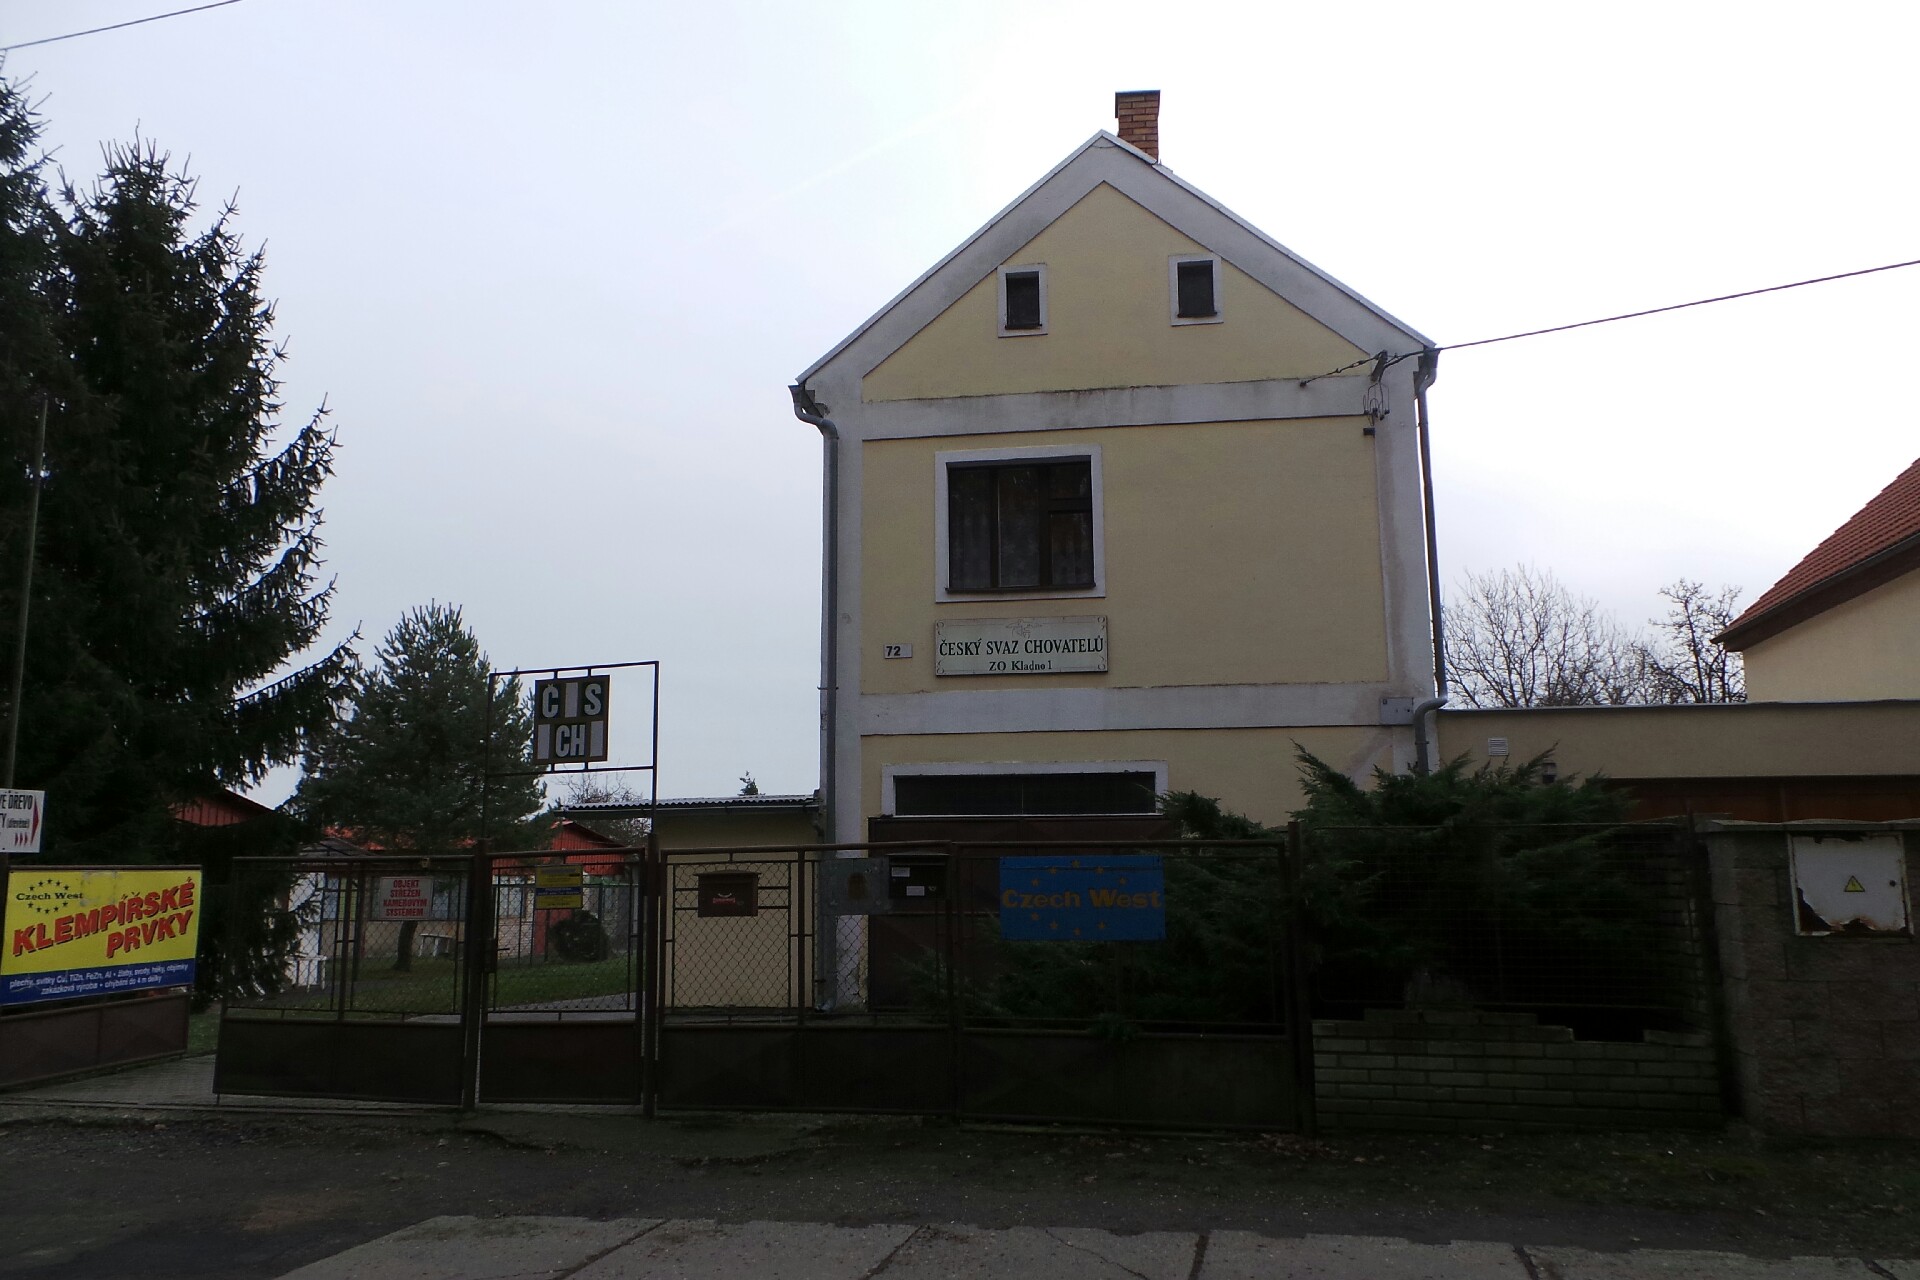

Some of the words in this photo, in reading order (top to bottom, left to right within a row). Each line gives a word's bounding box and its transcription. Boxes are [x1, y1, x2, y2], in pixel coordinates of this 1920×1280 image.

[885, 645, 901, 656] 72
[939, 638, 983, 656] ČESKÝ
[986, 640, 1019, 654] SVAZ
[1024, 636, 1103, 654] CHOVATELŮ
[989, 661, 1007, 671] ZO
[1011, 660, 1046, 671] Kladno
[393, 879, 420, 888] OBJEKT
[16, 893, 51, 901] Czech
[55, 892, 84, 900] West
[1002, 889, 1081, 908] Czech
[1088, 888, 1161, 908] West
[13, 877, 195, 956] KLEMPÍŘSKÉ
[107, 910, 193, 958] PRVKY
